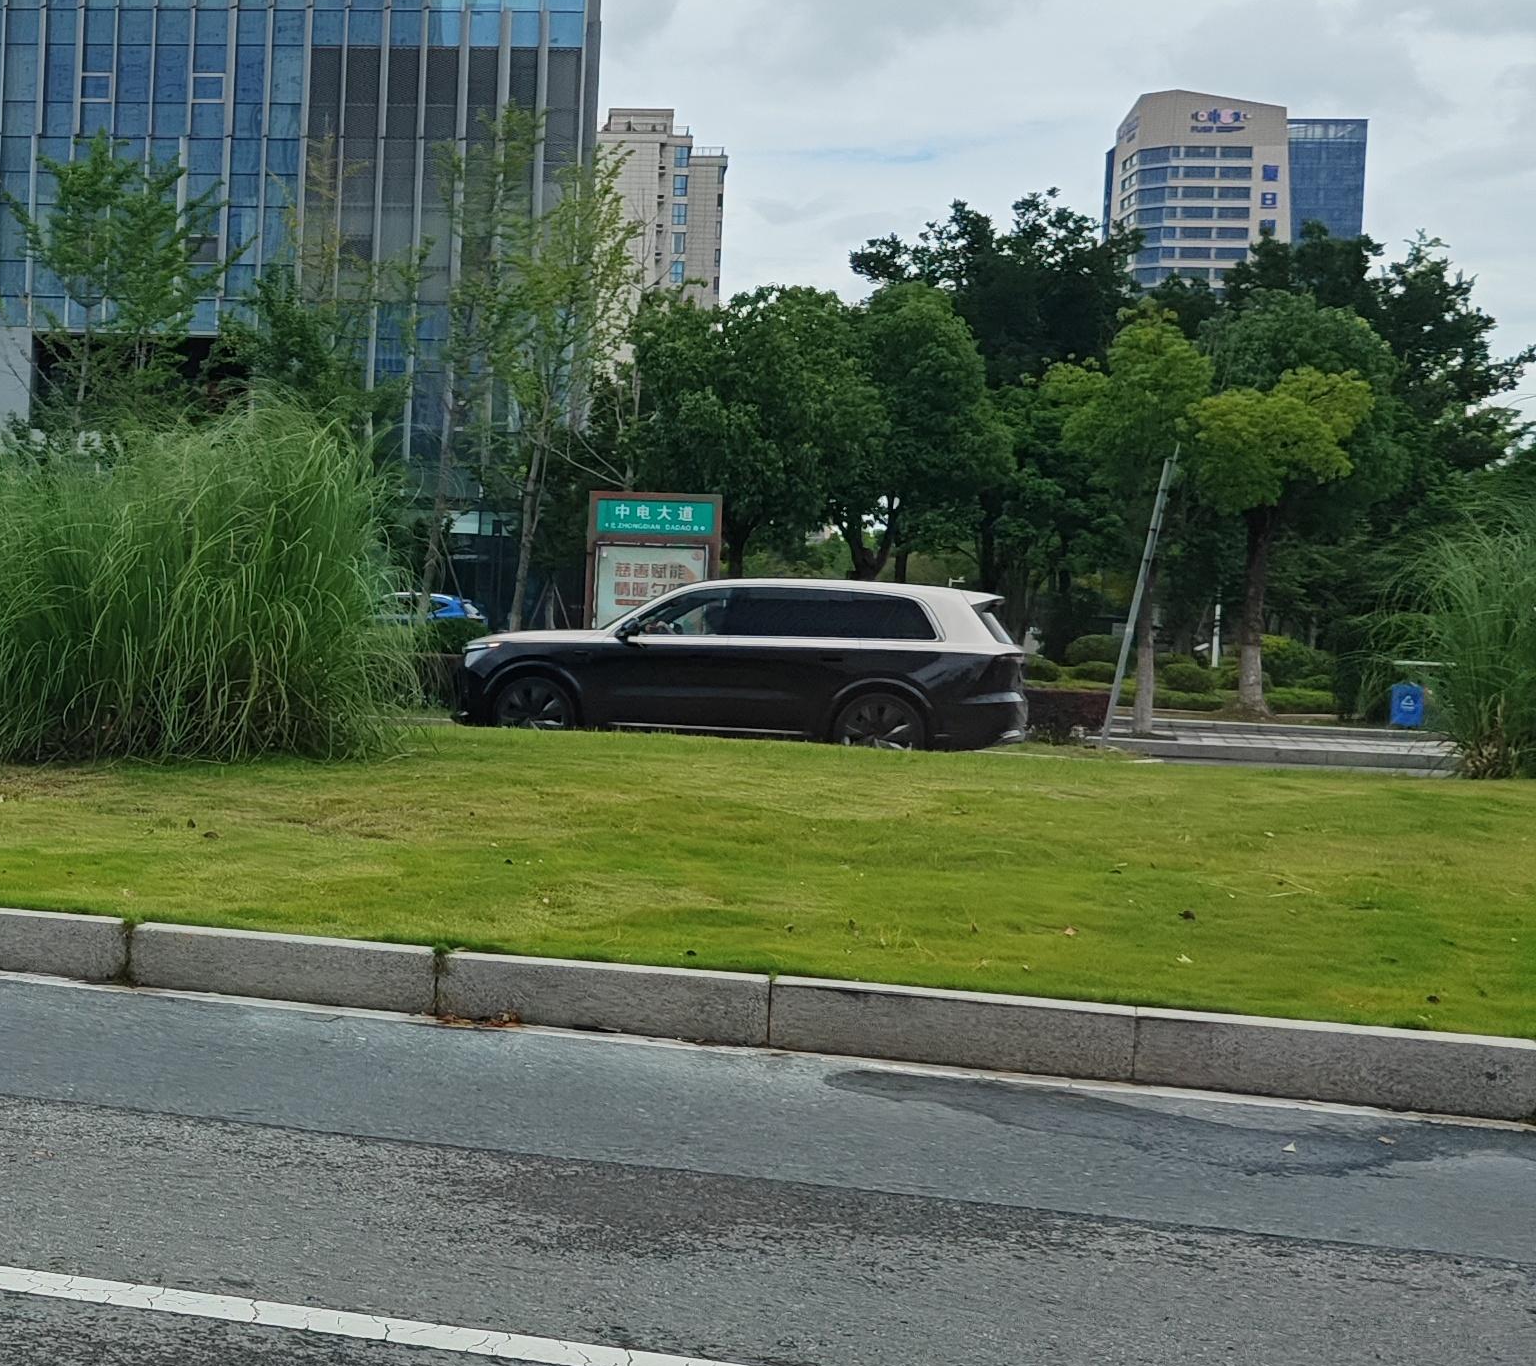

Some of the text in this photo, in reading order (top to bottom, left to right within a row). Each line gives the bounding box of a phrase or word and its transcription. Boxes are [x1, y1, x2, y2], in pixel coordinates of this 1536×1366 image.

[615, 503, 694, 522] 中电大道
[618, 522, 660, 530] ZHONGDIAN
[615, 562, 685, 579] 慈善赋能
